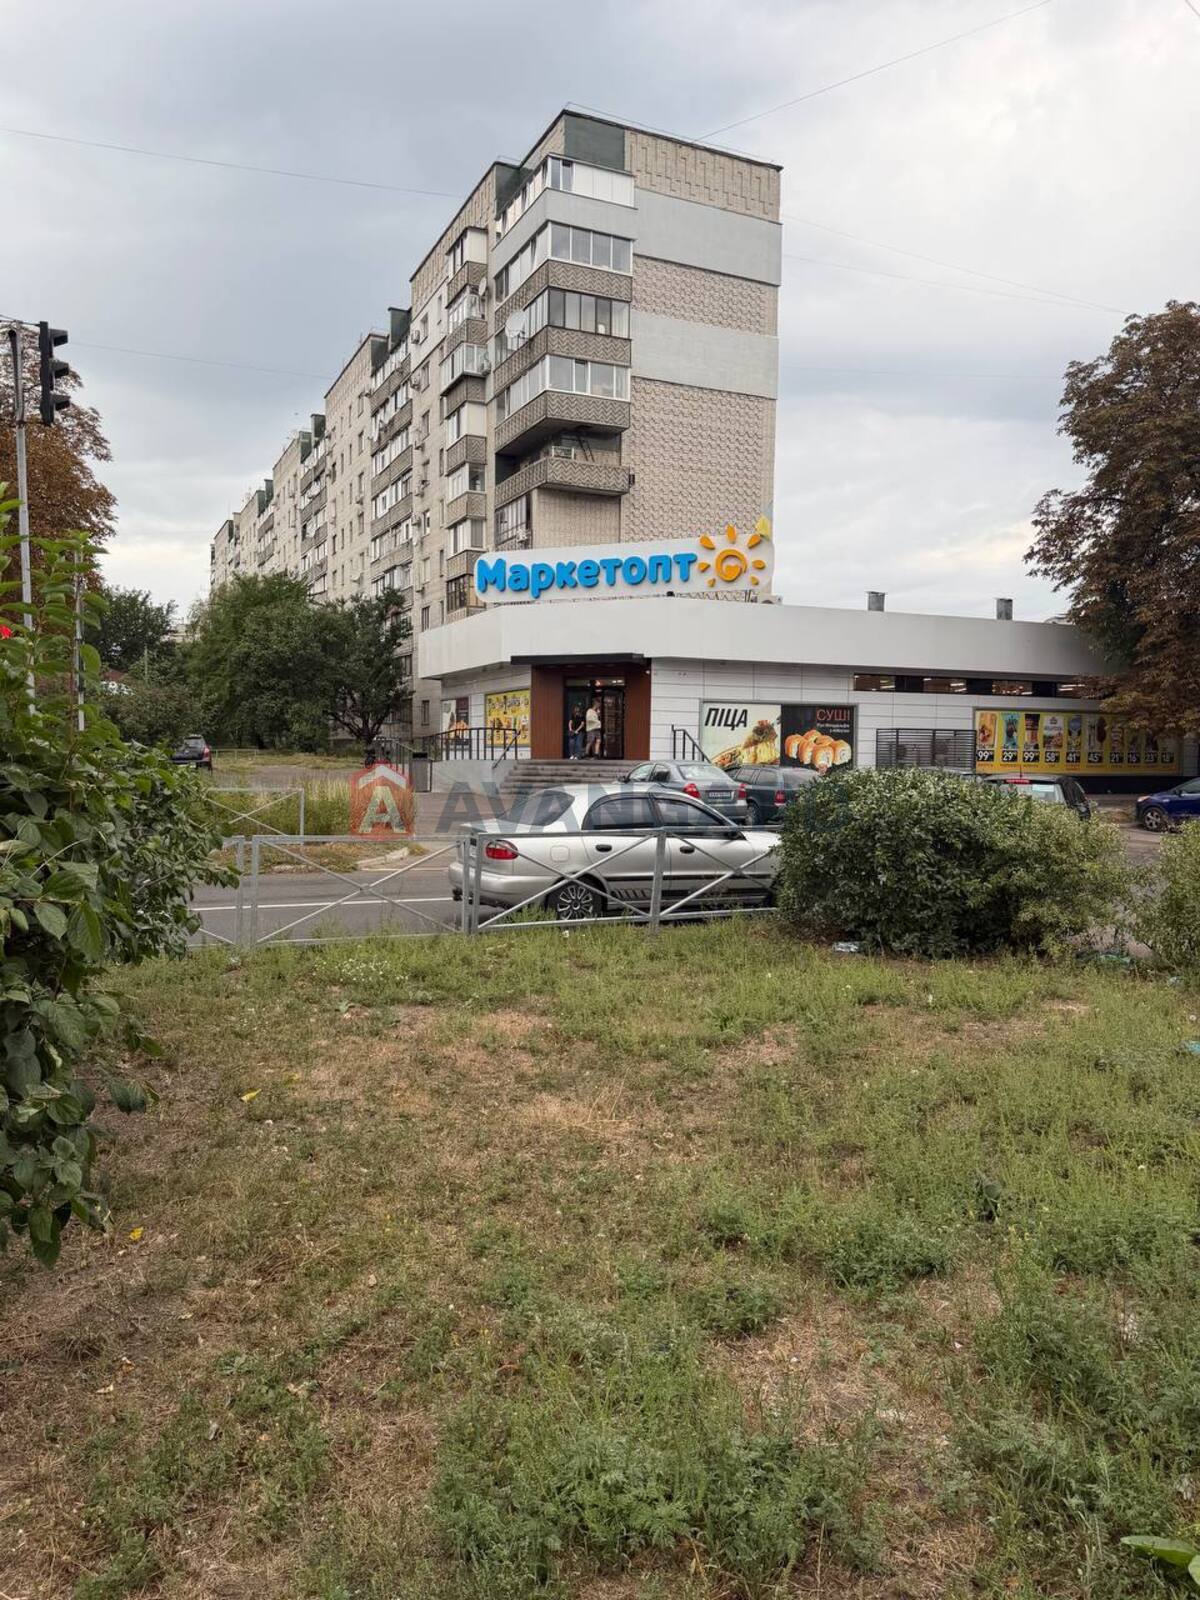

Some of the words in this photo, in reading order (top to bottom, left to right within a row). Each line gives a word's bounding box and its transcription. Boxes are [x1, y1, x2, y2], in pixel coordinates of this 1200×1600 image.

[477, 552, 698, 599] Маркетопт
[704, 707, 748, 731] ПІЦА
[816, 708, 850, 721] СУШІ
